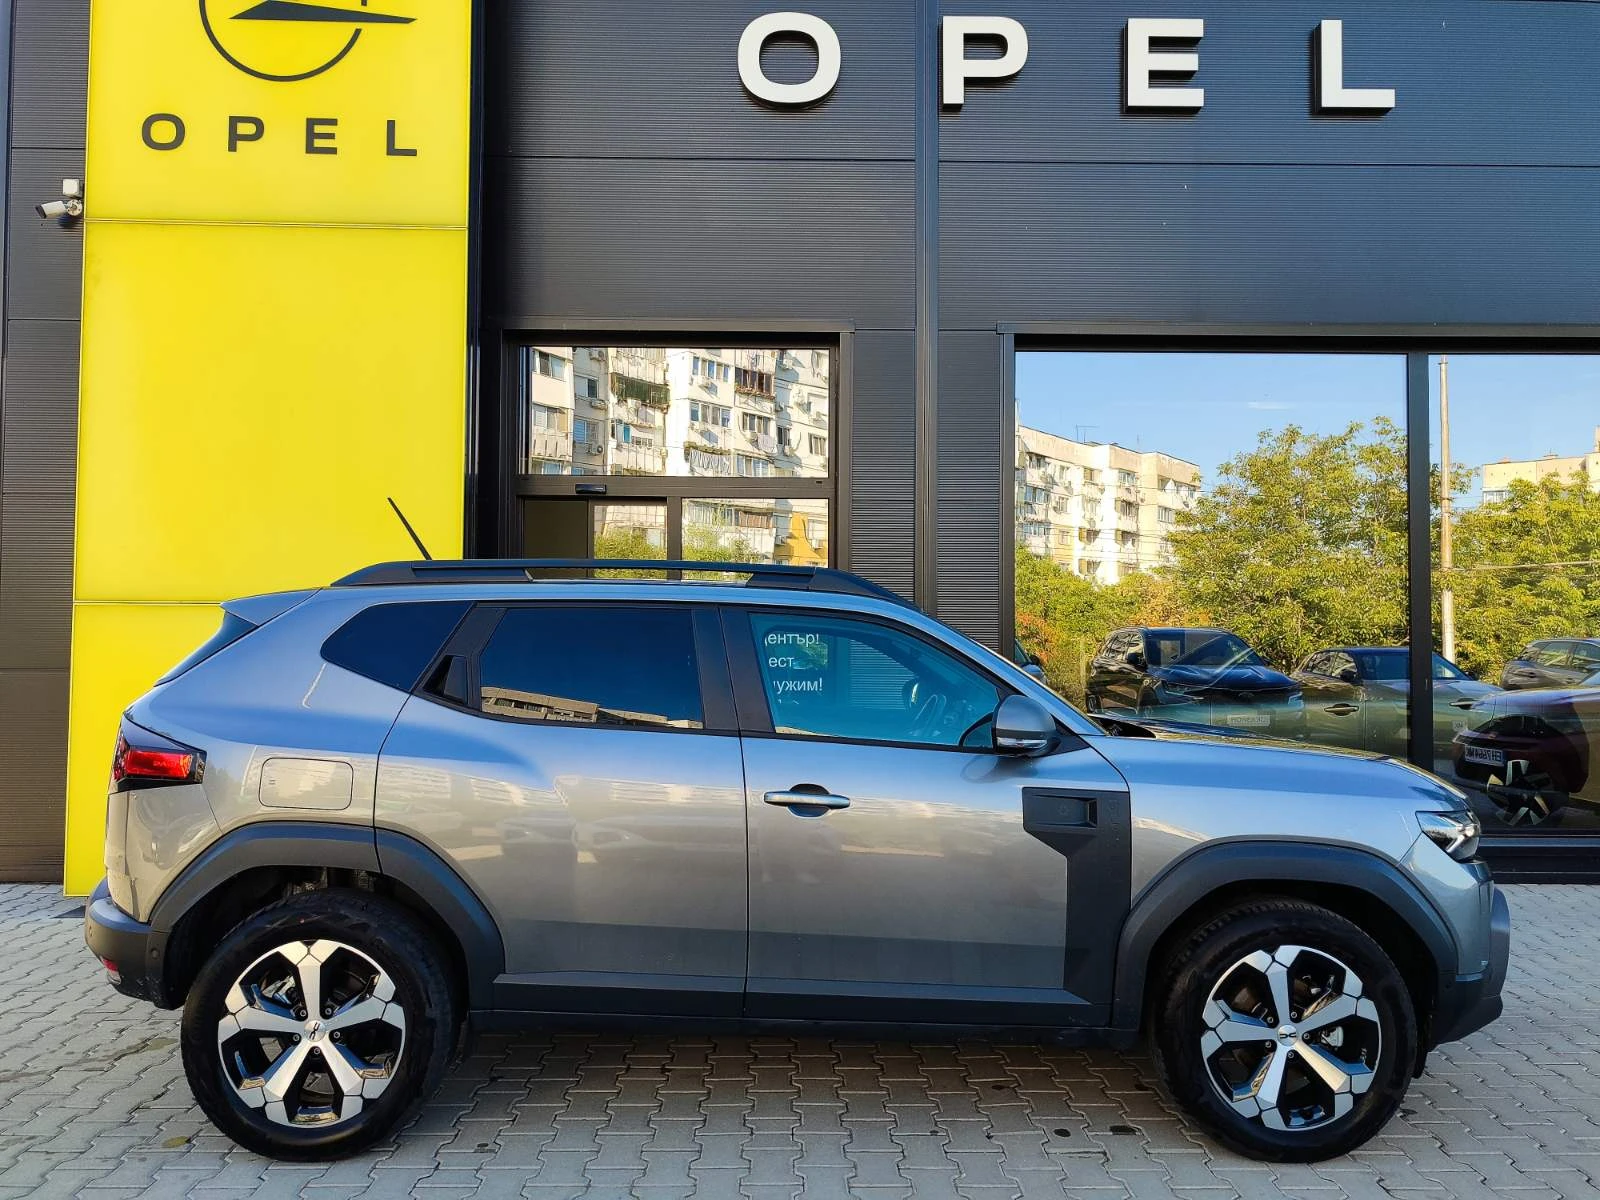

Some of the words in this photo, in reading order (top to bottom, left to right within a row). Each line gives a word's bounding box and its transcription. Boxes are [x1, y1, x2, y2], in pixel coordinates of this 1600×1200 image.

[738, 12, 1396, 108] OPEL
[142, 114, 417, 156] OPEL
[768, 656, 794, 668] ест
[773, 677, 822, 695] ужим!
